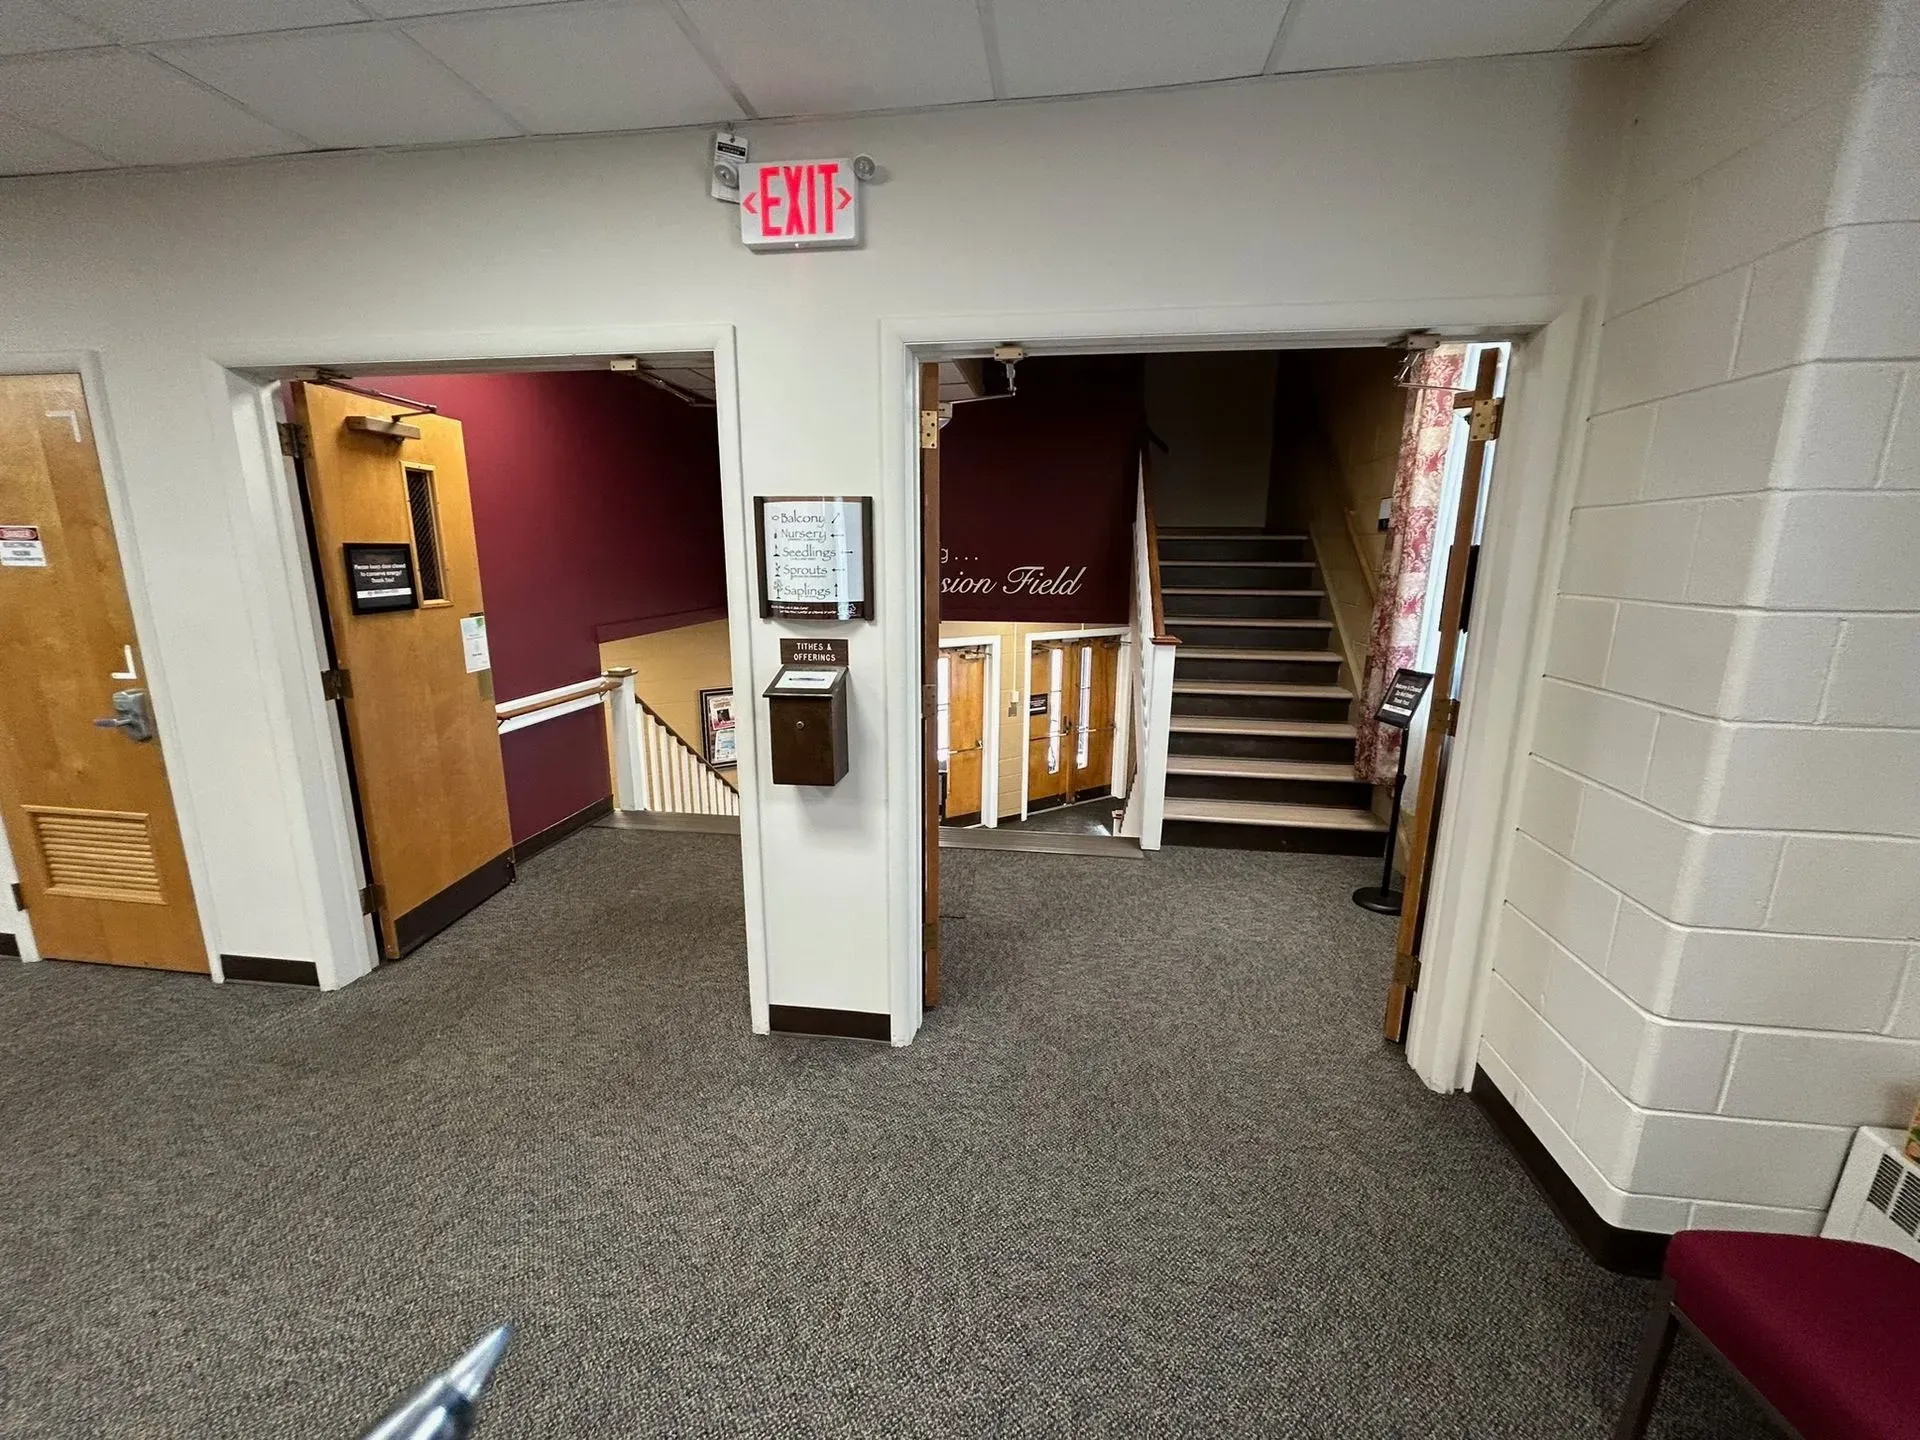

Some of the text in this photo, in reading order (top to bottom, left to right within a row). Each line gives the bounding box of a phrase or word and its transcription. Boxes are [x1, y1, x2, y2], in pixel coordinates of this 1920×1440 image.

[759, 164, 838, 236] EXIT
[781, 509, 825, 528] Balcony
[781, 529, 827, 543] Nursery
[782, 544, 836, 561] Seedlings
[783, 564, 828, 580] Sprouts
[1002, 566, 1087, 595] Field
[784, 583, 831, 600] Saplings
[796, 642, 832, 651] TITHES &
[793, 653, 836, 662] OFFERINGS
